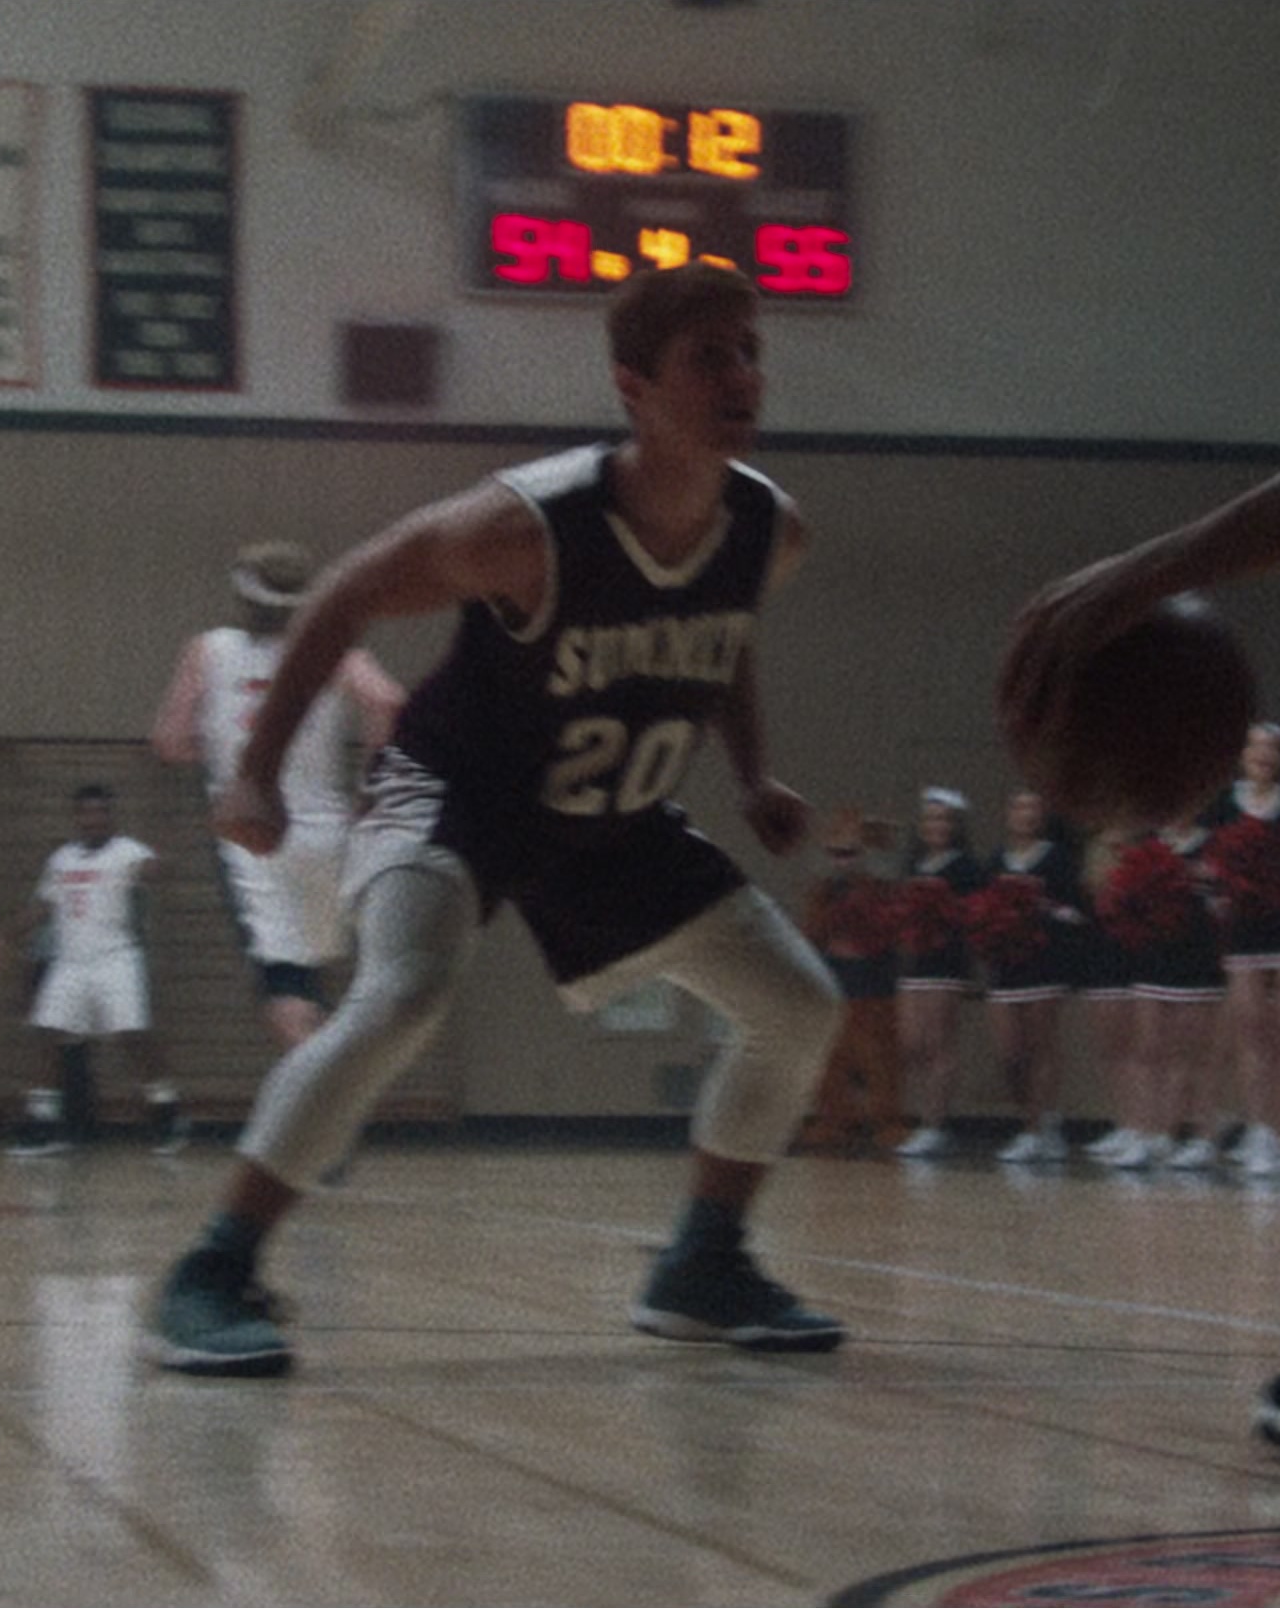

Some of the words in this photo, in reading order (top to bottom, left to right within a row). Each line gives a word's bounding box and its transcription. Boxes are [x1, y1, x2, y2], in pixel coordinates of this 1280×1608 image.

[565, 101, 762, 179] 00:12
[491, 213, 592, 285] 54
[755, 223, 852, 295] 55
[542, 716, 695, 816] 20
